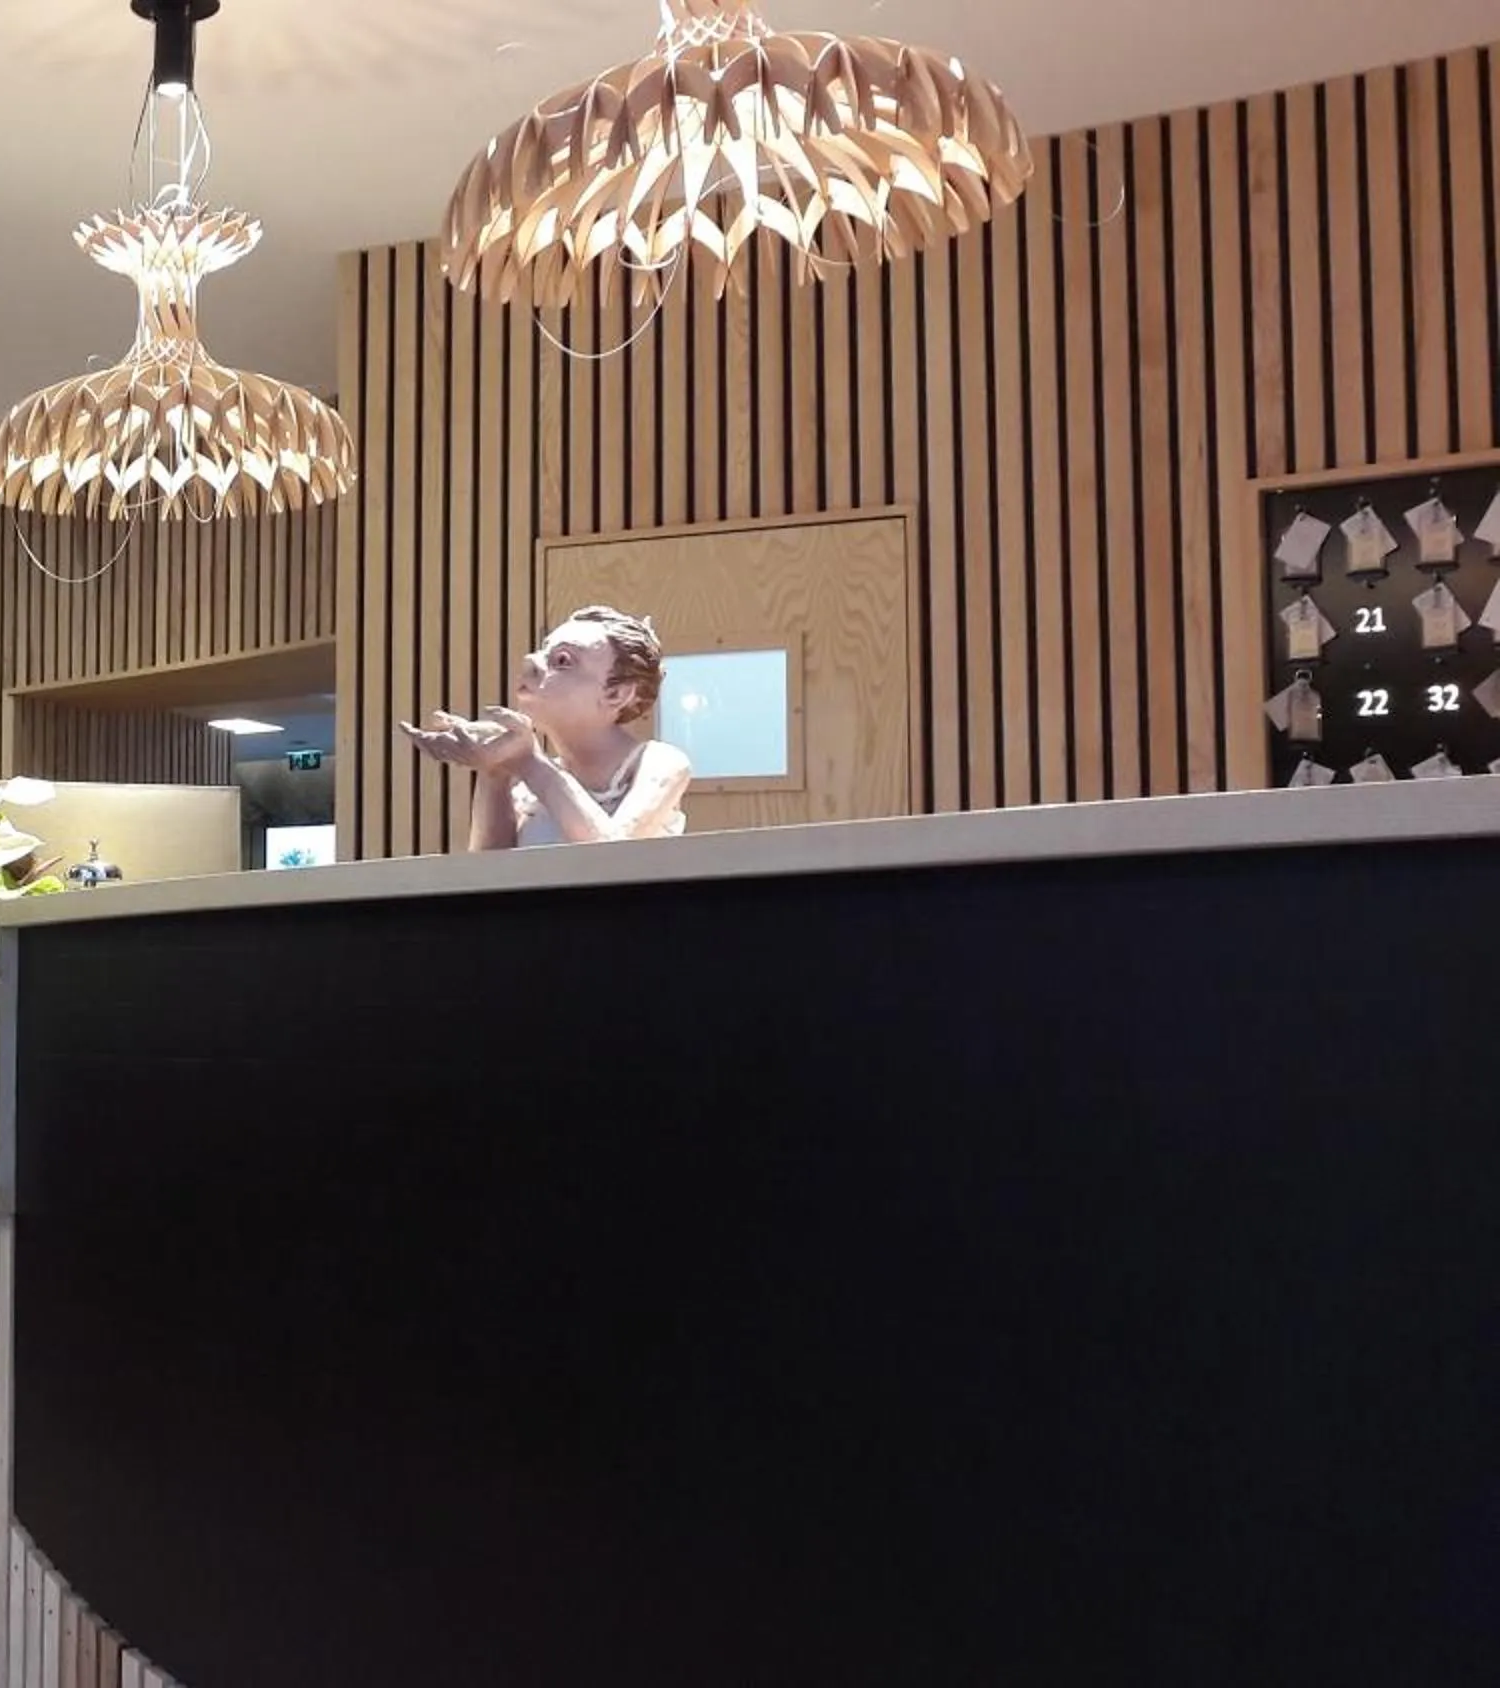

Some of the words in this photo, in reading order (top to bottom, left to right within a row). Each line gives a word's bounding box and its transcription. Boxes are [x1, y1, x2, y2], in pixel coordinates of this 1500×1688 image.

[1355, 607, 1387, 633] 21
[1357, 689, 1389, 716] 22
[1427, 684, 1460, 711] 32
